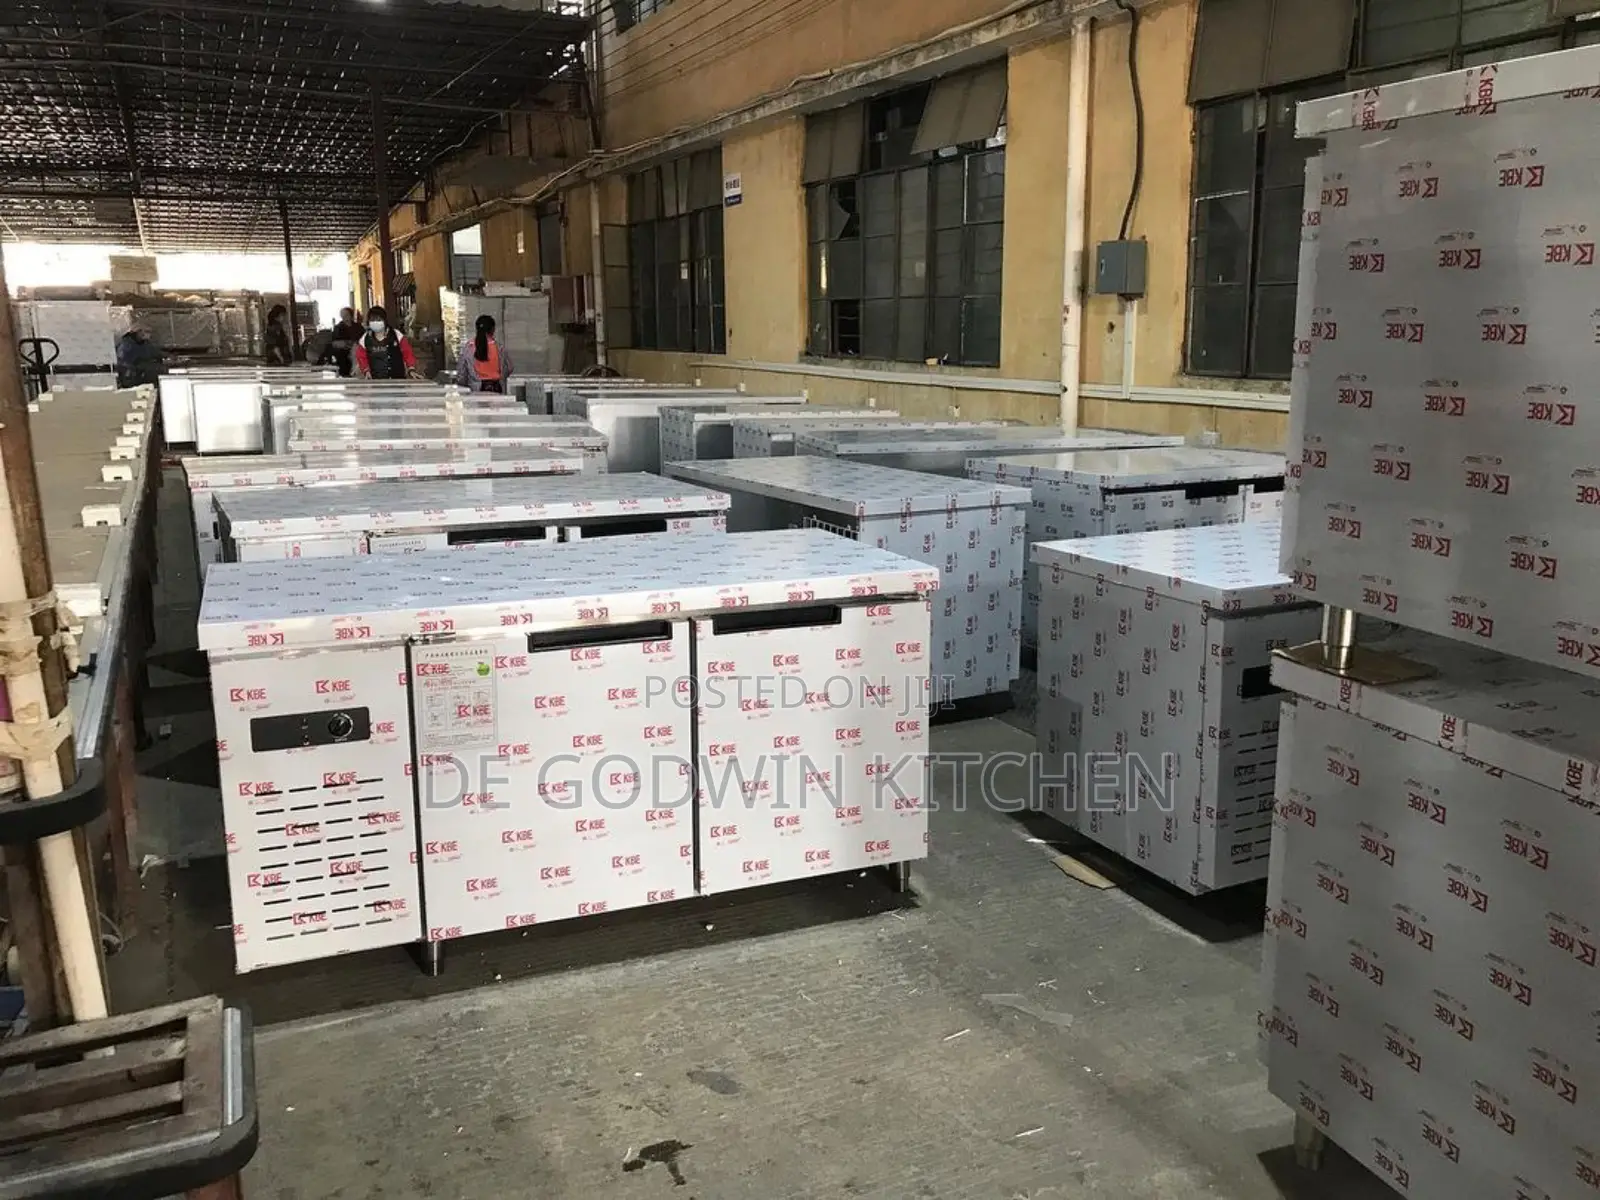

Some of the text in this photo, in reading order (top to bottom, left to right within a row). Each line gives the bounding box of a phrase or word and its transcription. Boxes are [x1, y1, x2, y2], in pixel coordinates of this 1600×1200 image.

[1478, 78, 1493, 105] KBE
[1363, 102, 1376, 130] KBE
[1499, 169, 1522, 186] KBE
[1400, 181, 1419, 198] KBE
[1350, 254, 1368, 270] KBE
[1439, 251, 1461, 268] KBE
[1545, 245, 1571, 263] KBE
[1386, 324, 1406, 339] KBE
[1482, 325, 1505, 341] KBE
[1339, 390, 1356, 404] KBE
[1425, 395, 1446, 411] KBE
[1528, 403, 1552, 420] KBE
[1374, 459, 1393, 474] KBE
[1466, 471, 1489, 488] KBE
[1328, 517, 1347, 532] KBE
[1412, 533, 1432, 550] KBE
[1510, 552, 1535, 571] KBE
[1363, 589, 1381, 604] KBE
[1452, 611, 1473, 628] KBE
[1558, 638, 1584, 656] KBE
[1441, 716, 1456, 741] KBE
[1328, 758, 1344, 776] KBE
[1566, 760, 1584, 788] KBE
[1409, 793, 1429, 813] KBE
[1360, 836, 1380, 854] KBE
[1504, 834, 1528, 856] KBE
[1316, 875, 1335, 893] KBE
[1447, 878, 1469, 900] KBE
[1397, 917, 1416, 938] KBE
[1549, 928, 1575, 950] KBE
[1350, 953, 1368, 972] KBE
[1489, 969, 1512, 991] KBE
[1308, 986, 1324, 1005] KBE
